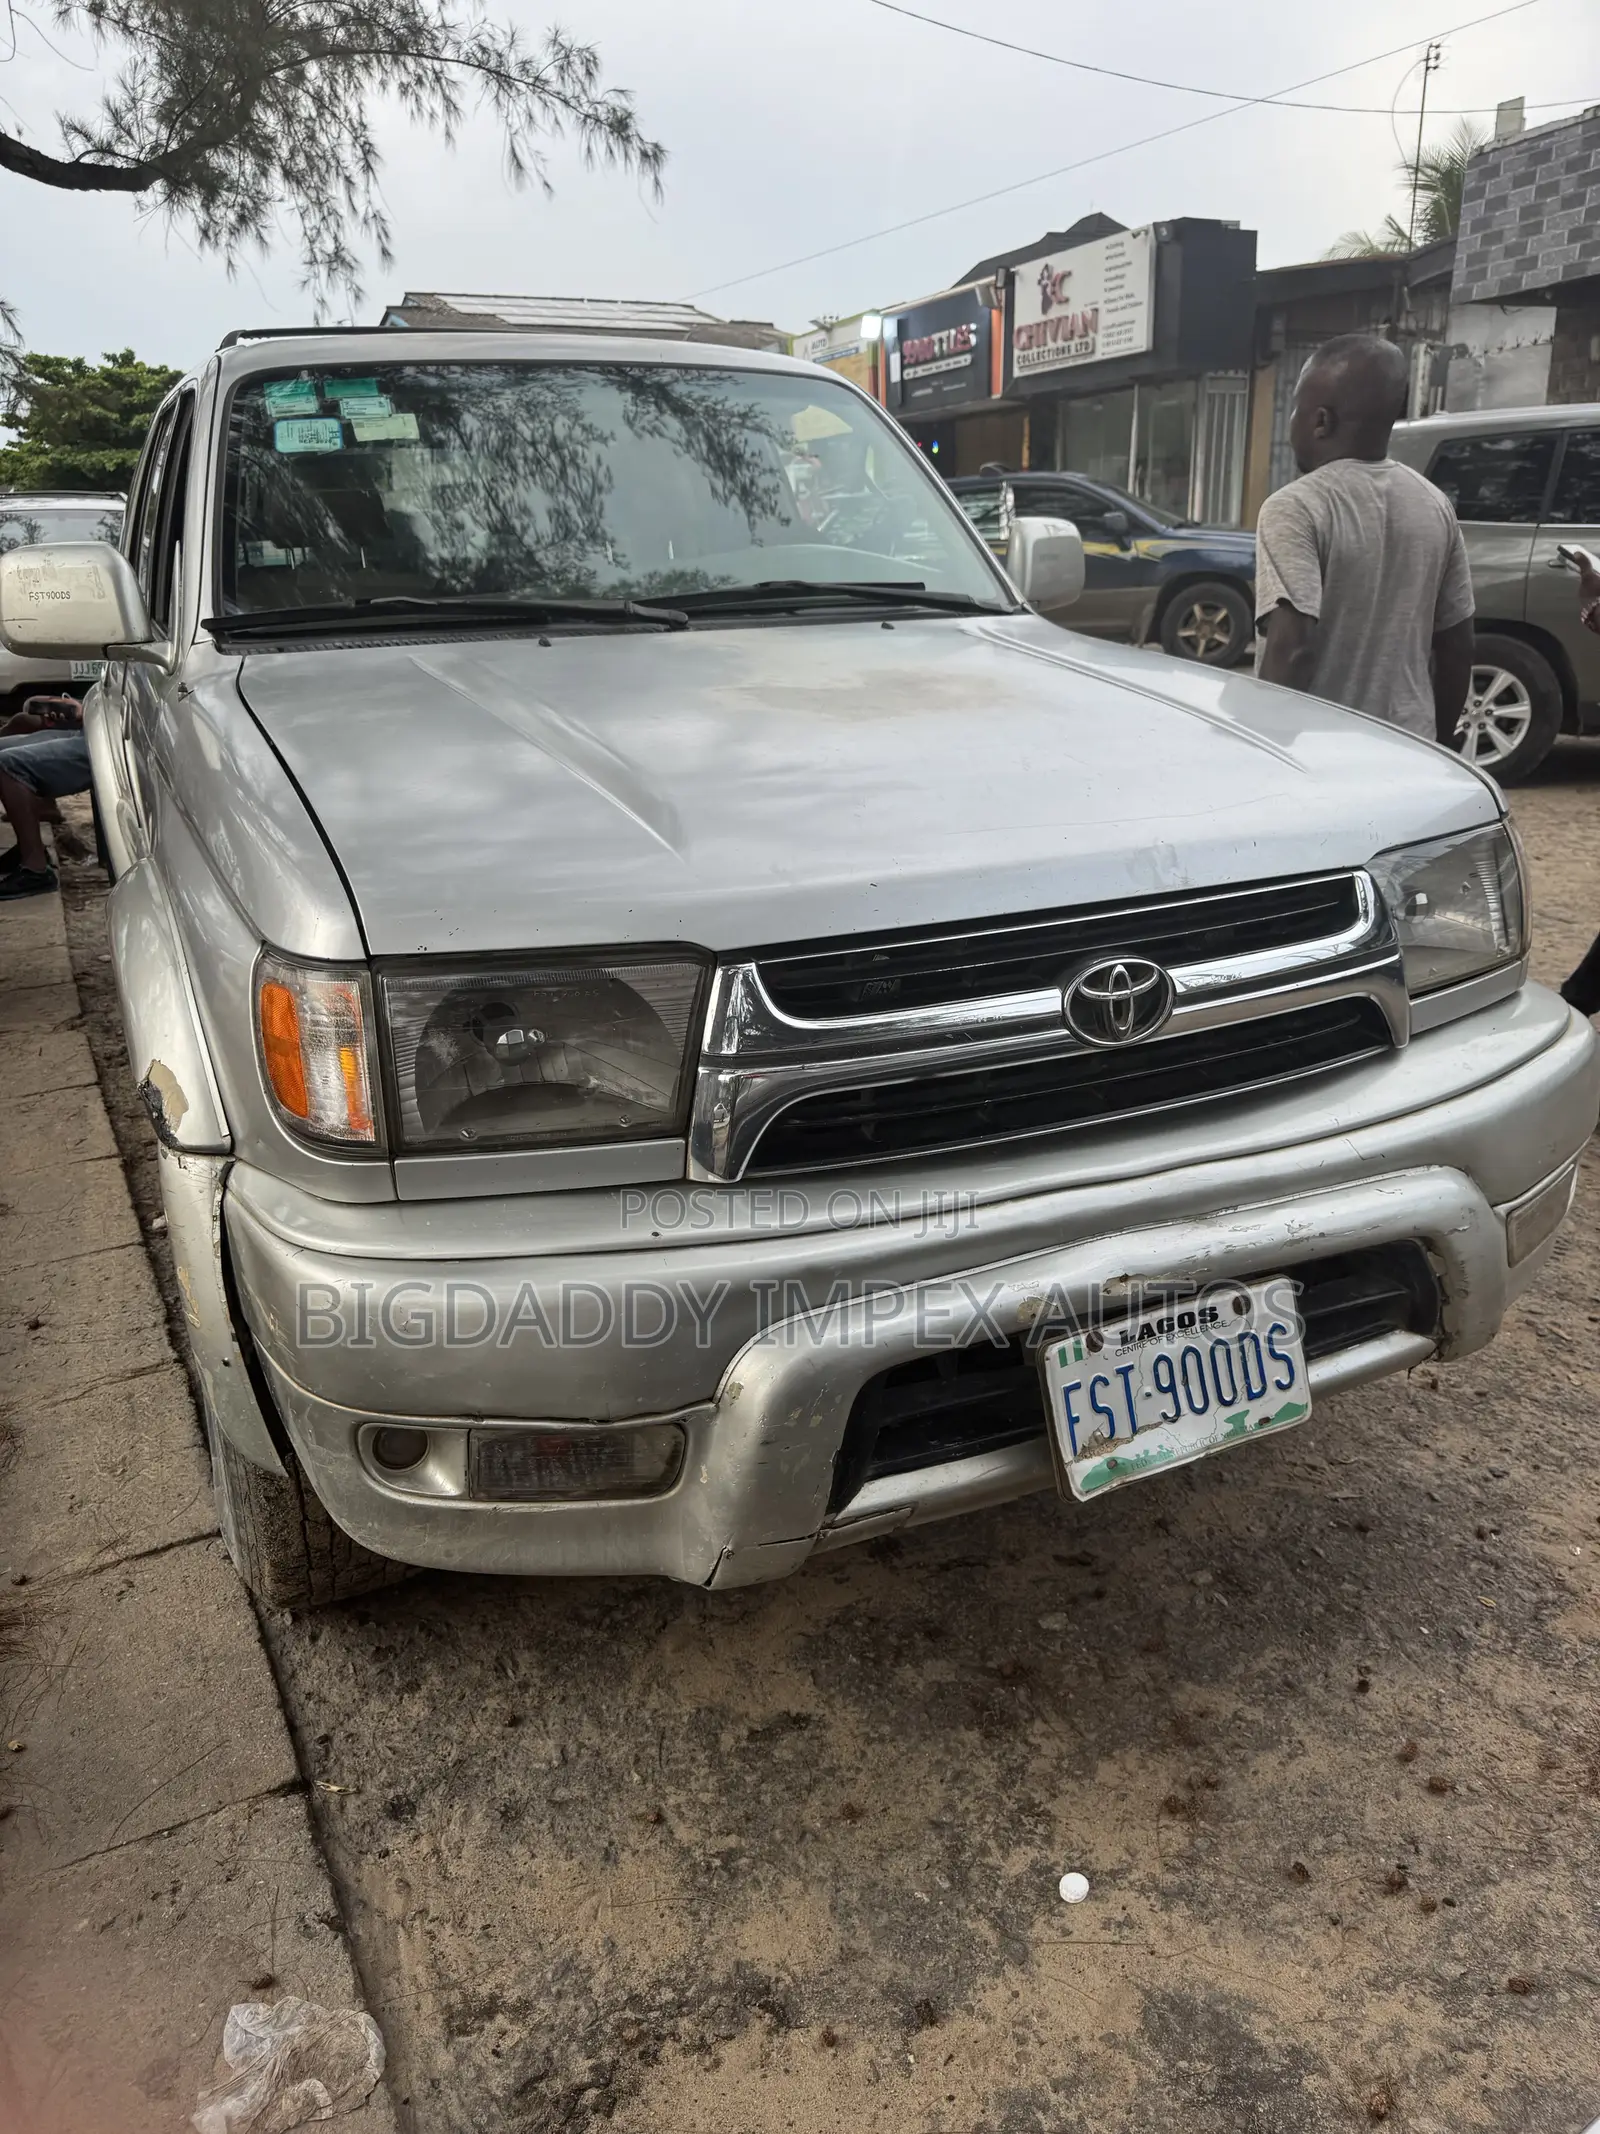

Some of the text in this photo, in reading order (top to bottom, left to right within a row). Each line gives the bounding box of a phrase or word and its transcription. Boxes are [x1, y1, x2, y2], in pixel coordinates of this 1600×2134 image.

[1017, 344, 1071, 365] COLLECTIONS
[1075, 341, 1090, 354] LTD
[1115, 1320, 1229, 1357] CENTRE OF EXCELLENCE
[1119, 1306, 1219, 1347] LAGOS
